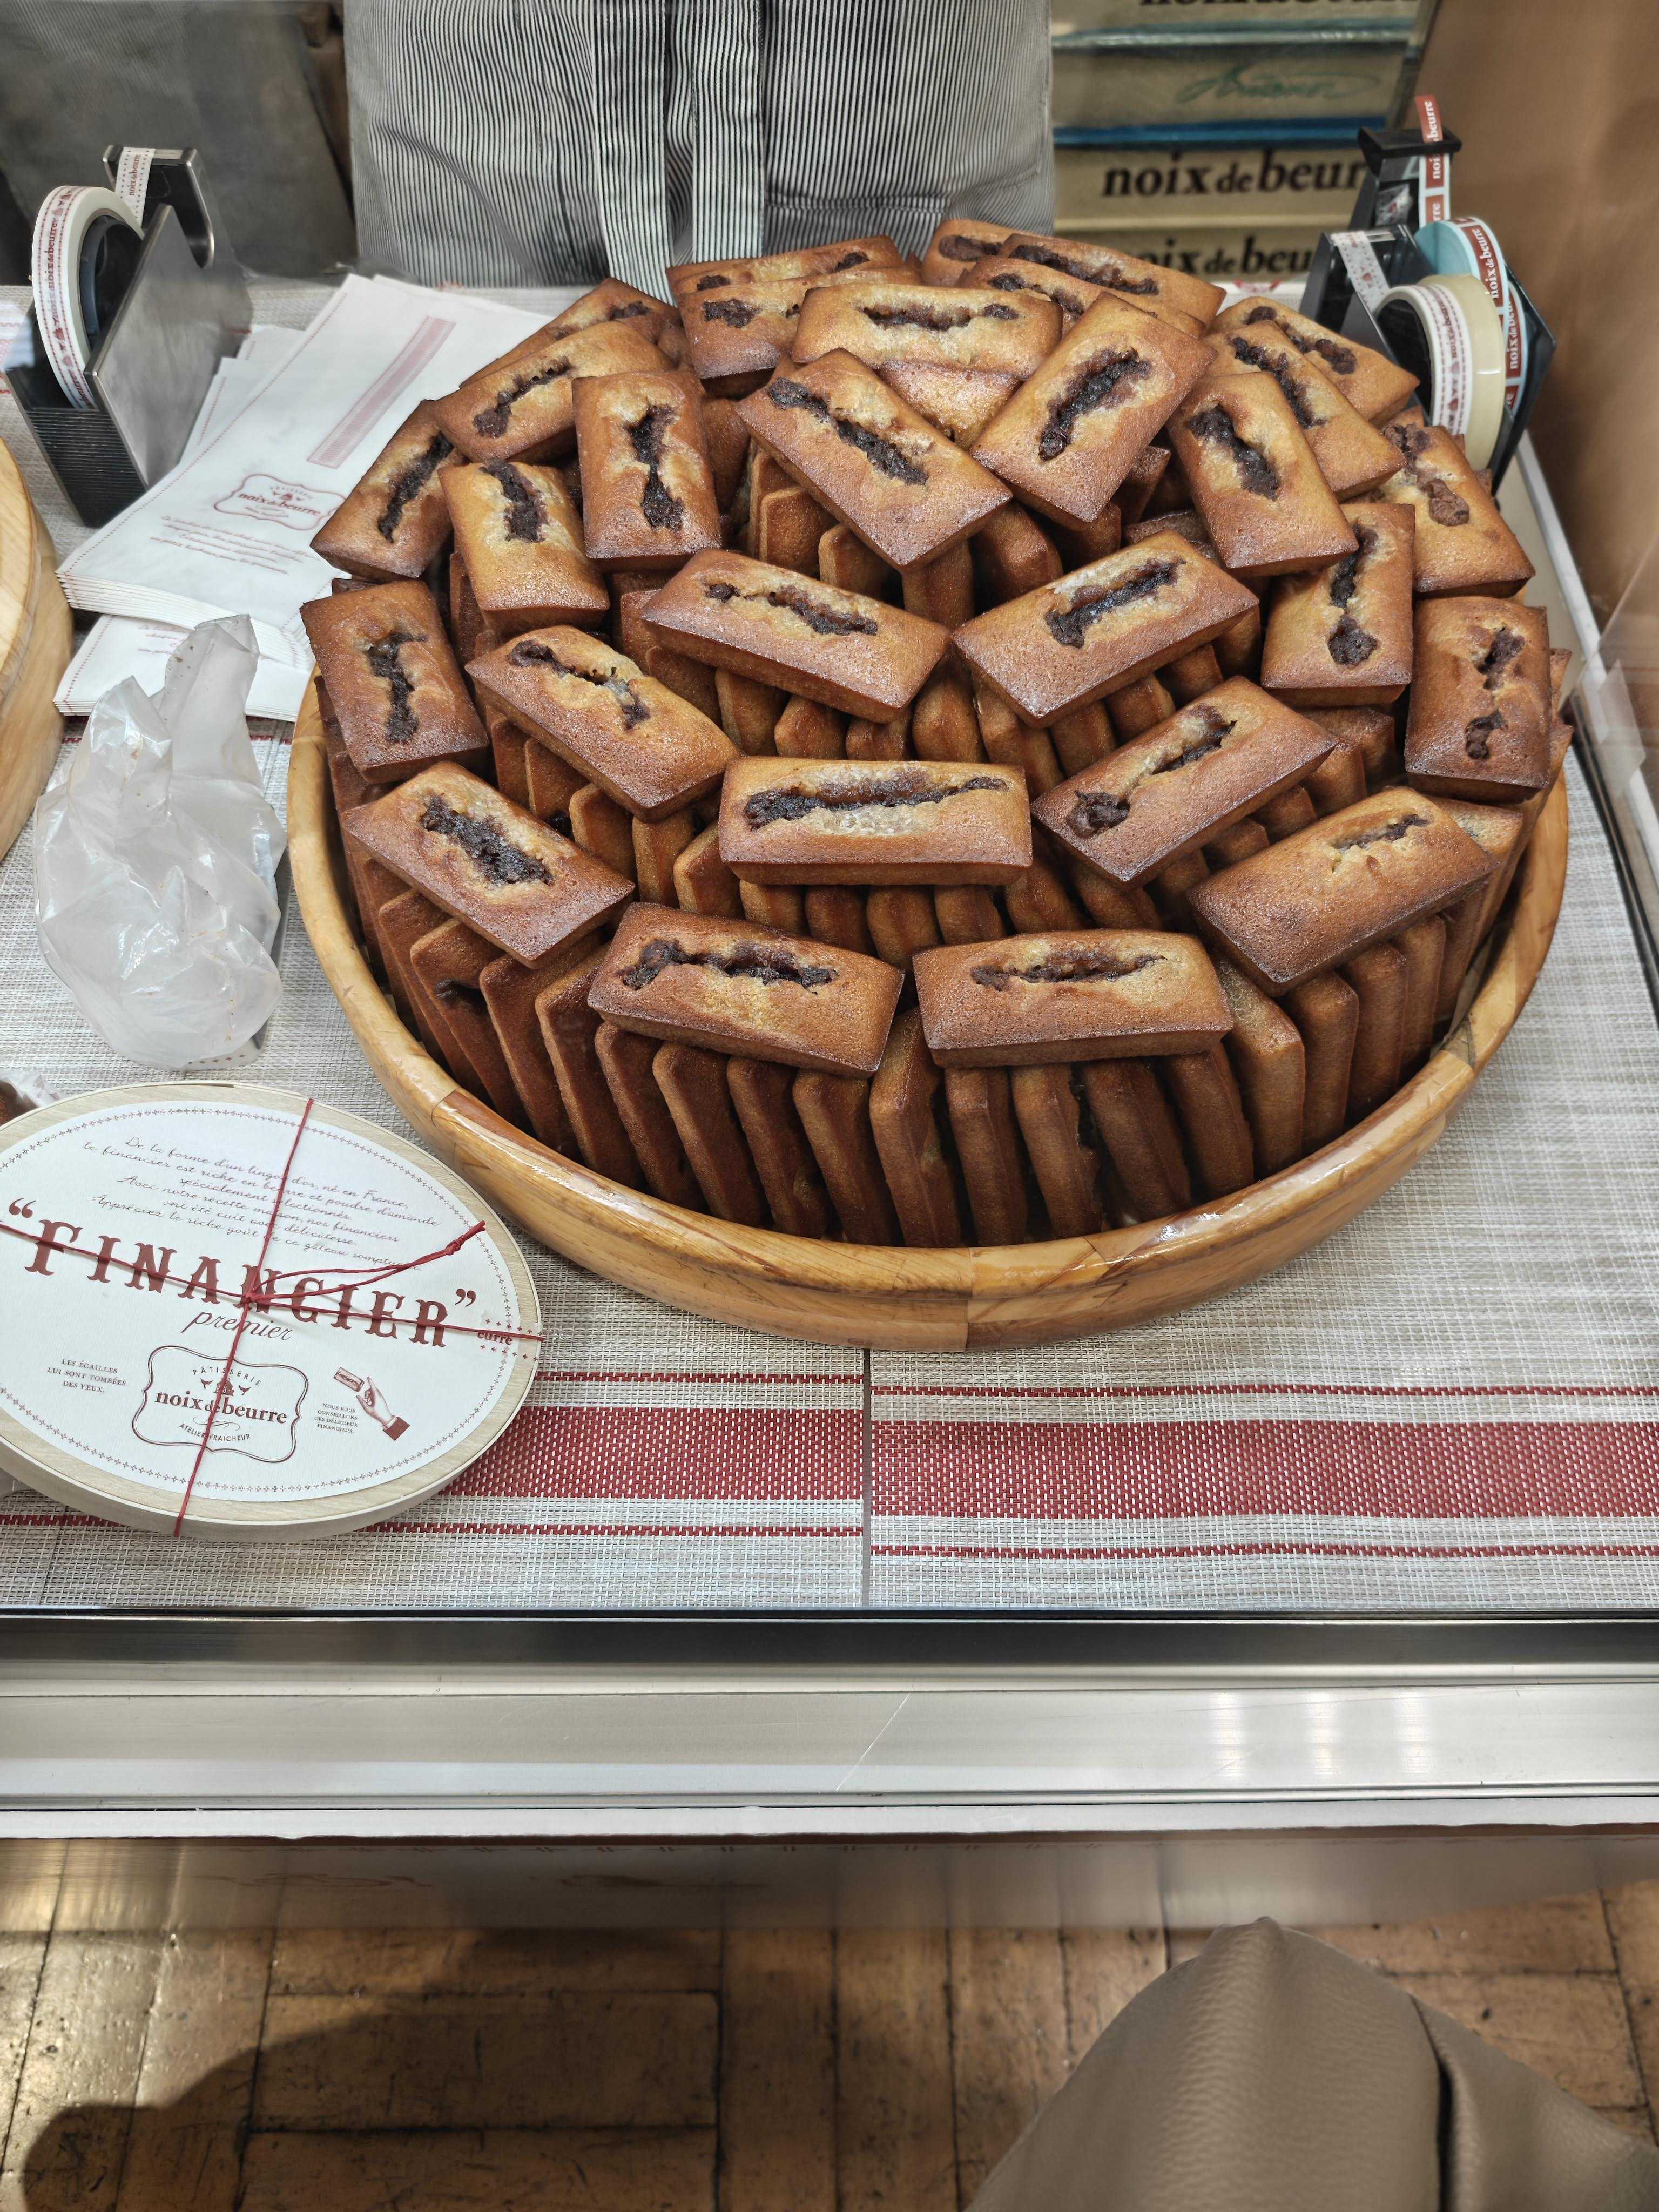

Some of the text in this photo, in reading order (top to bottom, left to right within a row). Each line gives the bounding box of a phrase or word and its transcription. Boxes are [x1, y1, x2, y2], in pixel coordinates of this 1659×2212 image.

[1424, 100, 1440, 139] beurre
[1102, 149, 1218, 197] noix
[1216, 163, 1255, 194] de
[1471, 228, 1492, 259] beurre
[1204, 248, 1235, 274] de
[1485, 267, 1499, 299] noix
[84, 1141, 98, 1151] le
[103, 1145, 173, 1168] financier
[177, 1164, 195, 1174] est
[201, 1170, 239, 1183] riche
[241, 1178, 259, 1188] en
[309, 1193, 325, 1202] et
[325, 1197, 373, 1213] poudre
[125, 1137, 146, 1149] De
[151, 1143, 164, 1154] la
[168, 1148, 211, 1165] forme
[362, 1190, 409, 1209] France,
[180, 1178, 269, 1203] spécialement
[117, 1175, 159, 1190] Avec
[163, 1188, 201, 1199] notre
[204, 1196, 252, 1211] recette
[307, 1218, 331, 1228] nos
[333, 1220, 401, 1243] financiers
[163, 1199, 188, 1210] ont
[191, 1205, 212, 1215] été
[217, 1210, 247, 1222] cuit
[86, 1194, 165, 1218] Appréciez
[168, 1211, 184, 1222] le
[188, 1217, 225, 1230] riche
[226, 1225, 261, 1238] goût
[285, 1238, 301, 1246] ce
[303, 1242, 350, 1257] gâteau
[180, 1311, 293, 1341] premier
[47, 1366, 126, 1386] LUI SONT TOMBÉES
[79, 1360, 118, 1374] ÉCAILLES
[80, 1383, 105, 1393] YEUX.
[154, 1391, 204, 1411] noix
[222, 1397, 288, 1424] beurre
[317, 1410, 358, 1420] CONSEILLONS
[179, 1423, 251, 1442] ATELIER FRAICHEUR
[316, 1423, 355, 1434] FINANCIERS.
[326, 1417, 359, 1427] DÉLICIEUX
